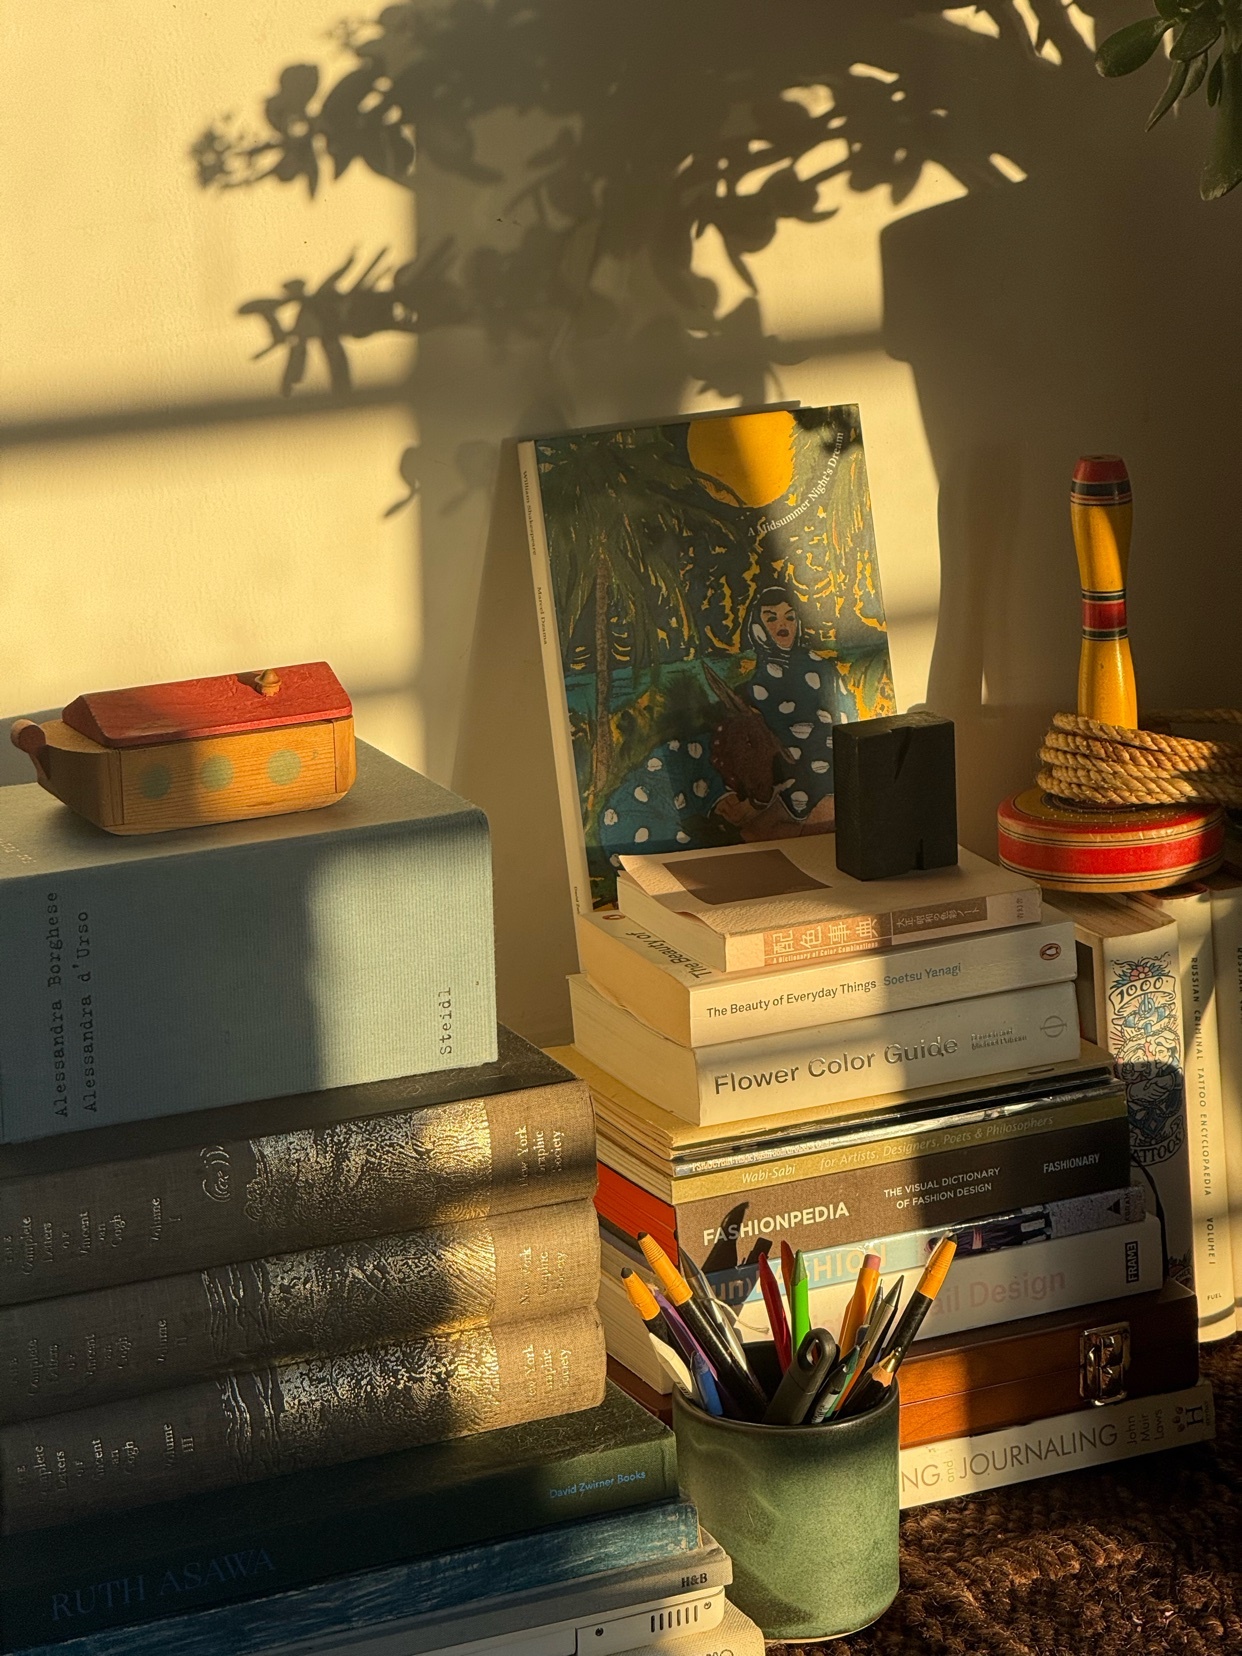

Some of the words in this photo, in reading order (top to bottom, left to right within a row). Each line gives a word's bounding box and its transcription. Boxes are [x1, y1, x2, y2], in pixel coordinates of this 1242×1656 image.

[748, 527, 756, 537] A
[757, 499, 810, 534] Midsummer
[808, 467, 834, 502] Night's
[828, 432, 844, 468] Dream
[47, 891, 63, 988] Borghese
[72, 911, 91, 983] d'Urso
[649, 938, 688, 964] Beauty
[773, 917, 879, 955] 配色事典
[778, 953, 811, 964] Dictionary
[820, 947, 837, 957] Color
[838, 942, 879, 954] Combinations
[685, 962, 712, 979] The
[706, 1004, 728, 1019] The
[730, 998, 770, 1014] Beauty
[772, 994, 785, 1007] of
[786, 985, 838, 1004] Everyday
[840, 978, 877, 996] Things
[883, 972, 923, 987] Soetsu
[924, 963, 962, 981] Yanagi
[1115, 976, 1164, 1006] 1000
[1190, 957, 1200, 1002] RUSSIAN
[438, 985, 452, 1055] Steidl
[1194, 1010, 1204, 1060] CRIMINAL
[48, 999, 68, 1118] Alessandra
[80, 994, 98, 1113] Alessandra
[713, 1064, 800, 1095] Flower
[807, 1051, 877, 1079] Color
[884, 1036, 959, 1065] Guide
[1197, 1067, 1208, 1108] TATTOO
[515, 1125, 529, 1157] York
[533, 1130, 546, 1178] Graphic
[742, 1163, 796, 1184] Wabi-Sabi
[820, 1156, 836, 1171] for
[839, 1149, 880, 1166] Artists,
[883, 1137, 941, 1158] Designers,
[943, 1130, 971, 1146] Poets
[974, 1127, 983, 1139] &
[986, 1115, 1053, 1138] Philosophers
[1131, 1131, 1182, 1163] ATTOOS
[1200, 1113, 1212, 1196] ENCYCLOPAEDIA
[884, 1186, 903, 1199] THE
[904, 1180, 940, 1195] VISUAL
[941, 1167, 1000, 1187] DICTIONARY
[1043, 1152, 1100, 1174] FASHIONARY
[896, 1199, 910, 1210] OF
[912, 1191, 954, 1206] FASHION
[956, 1182, 992, 1198] DESIGN
[703, 1202, 850, 1246] FASHIONPEDIA
[1206, 1217, 1216, 1258] VOLUME
[969, 1269, 1067, 1311] Design
[1206, 1292, 1222, 1301] FUEL
[1127, 1415, 1137, 1446] John
[1140, 1412, 1150, 1442] Muir
[1154, 1409, 1164, 1440] Laws
[958, 1423, 1118, 1480] JOURNALING
[550, 1482, 577, 1498] David
[578, 1477, 614, 1494] Zwirner
[617, 1470, 646, 1485] Books
[51, 1575, 146, 1621] RUTH
[159, 1548, 277, 1596] ASAWA
[681, 1572, 708, 1588] H&B
